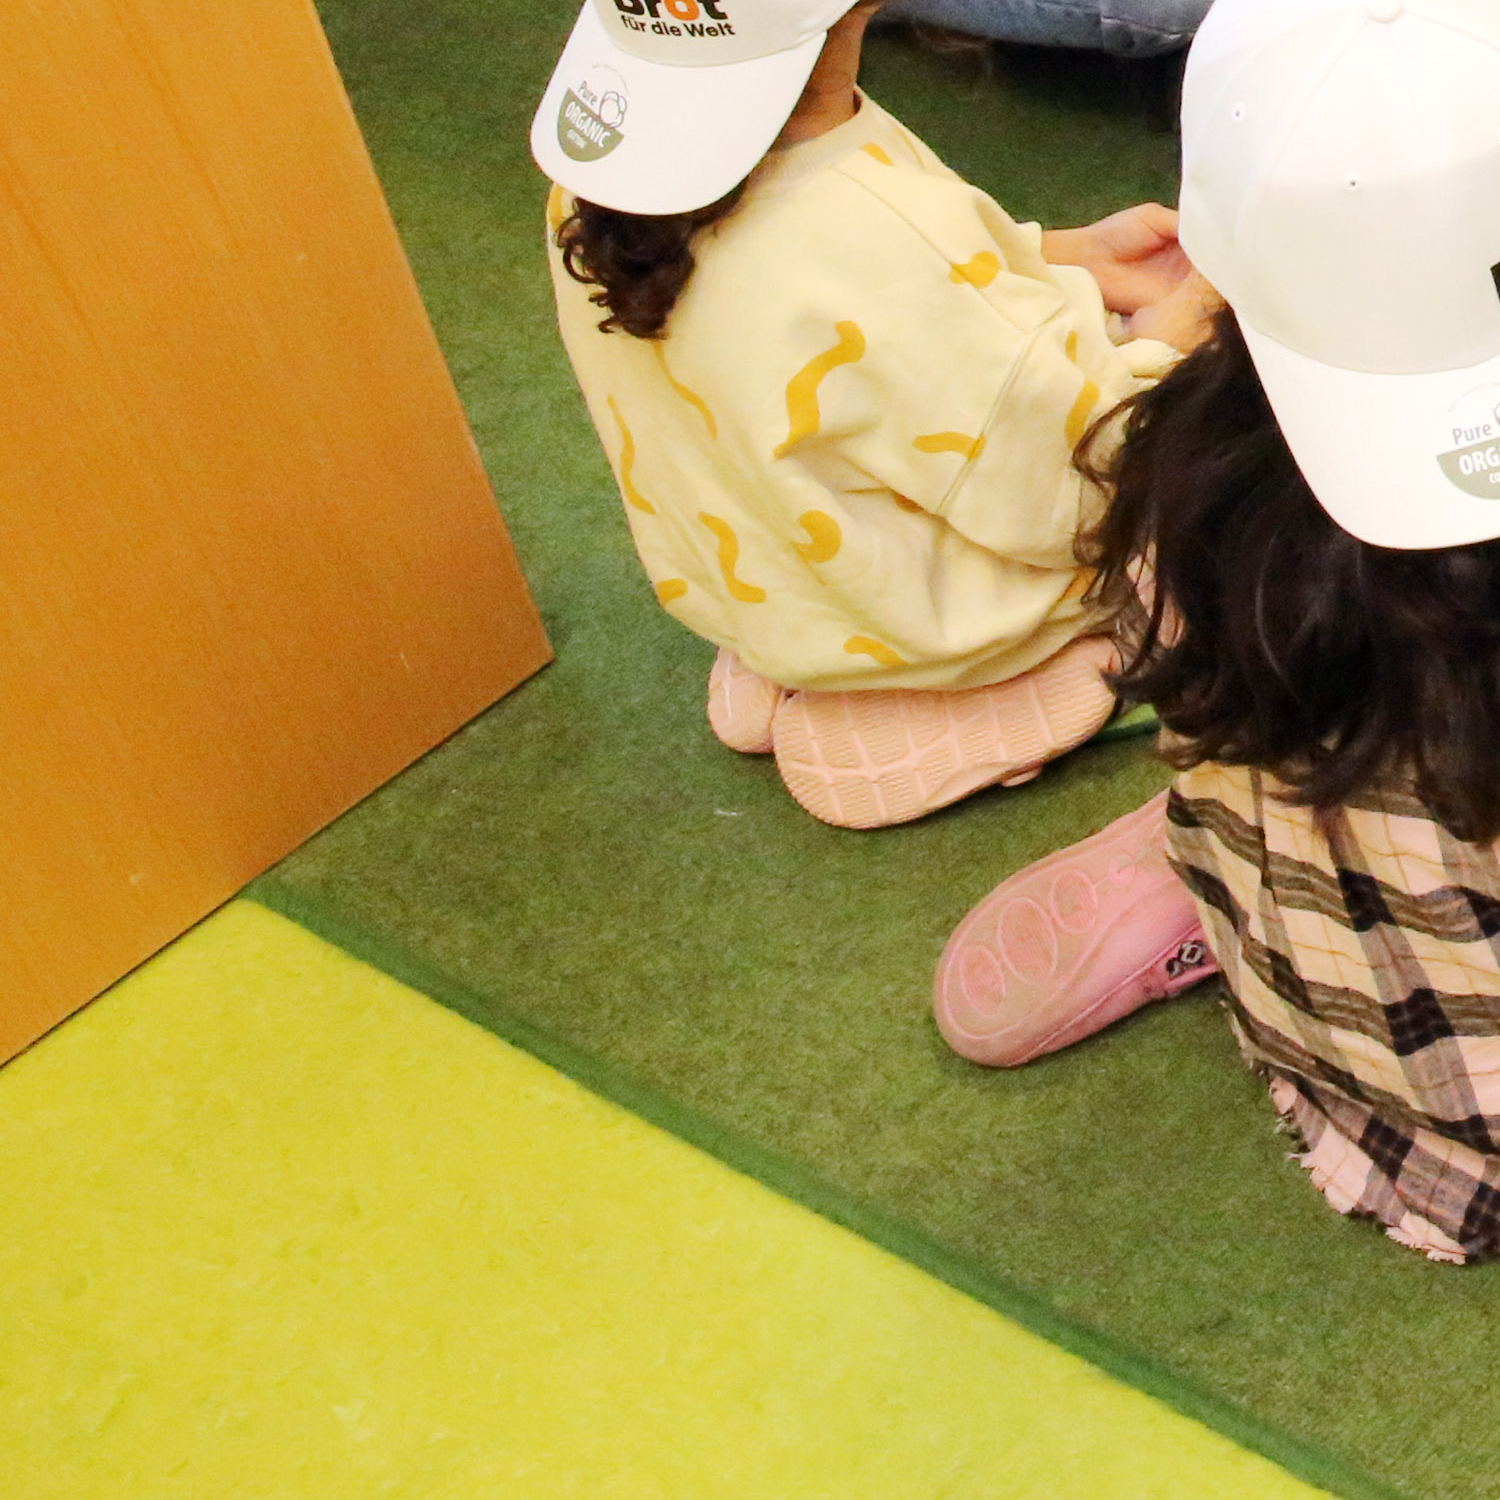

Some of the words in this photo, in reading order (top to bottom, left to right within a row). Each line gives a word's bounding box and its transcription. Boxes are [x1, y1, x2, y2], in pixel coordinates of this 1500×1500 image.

[621, 15, 647, 33] für
[651, 21, 682, 37] die
[683, 22, 736, 37] Welt
[578, 80, 598, 106] Pure
[565, 101, 611, 148] ORGANIC
[1452, 424, 1492, 445] Pure
